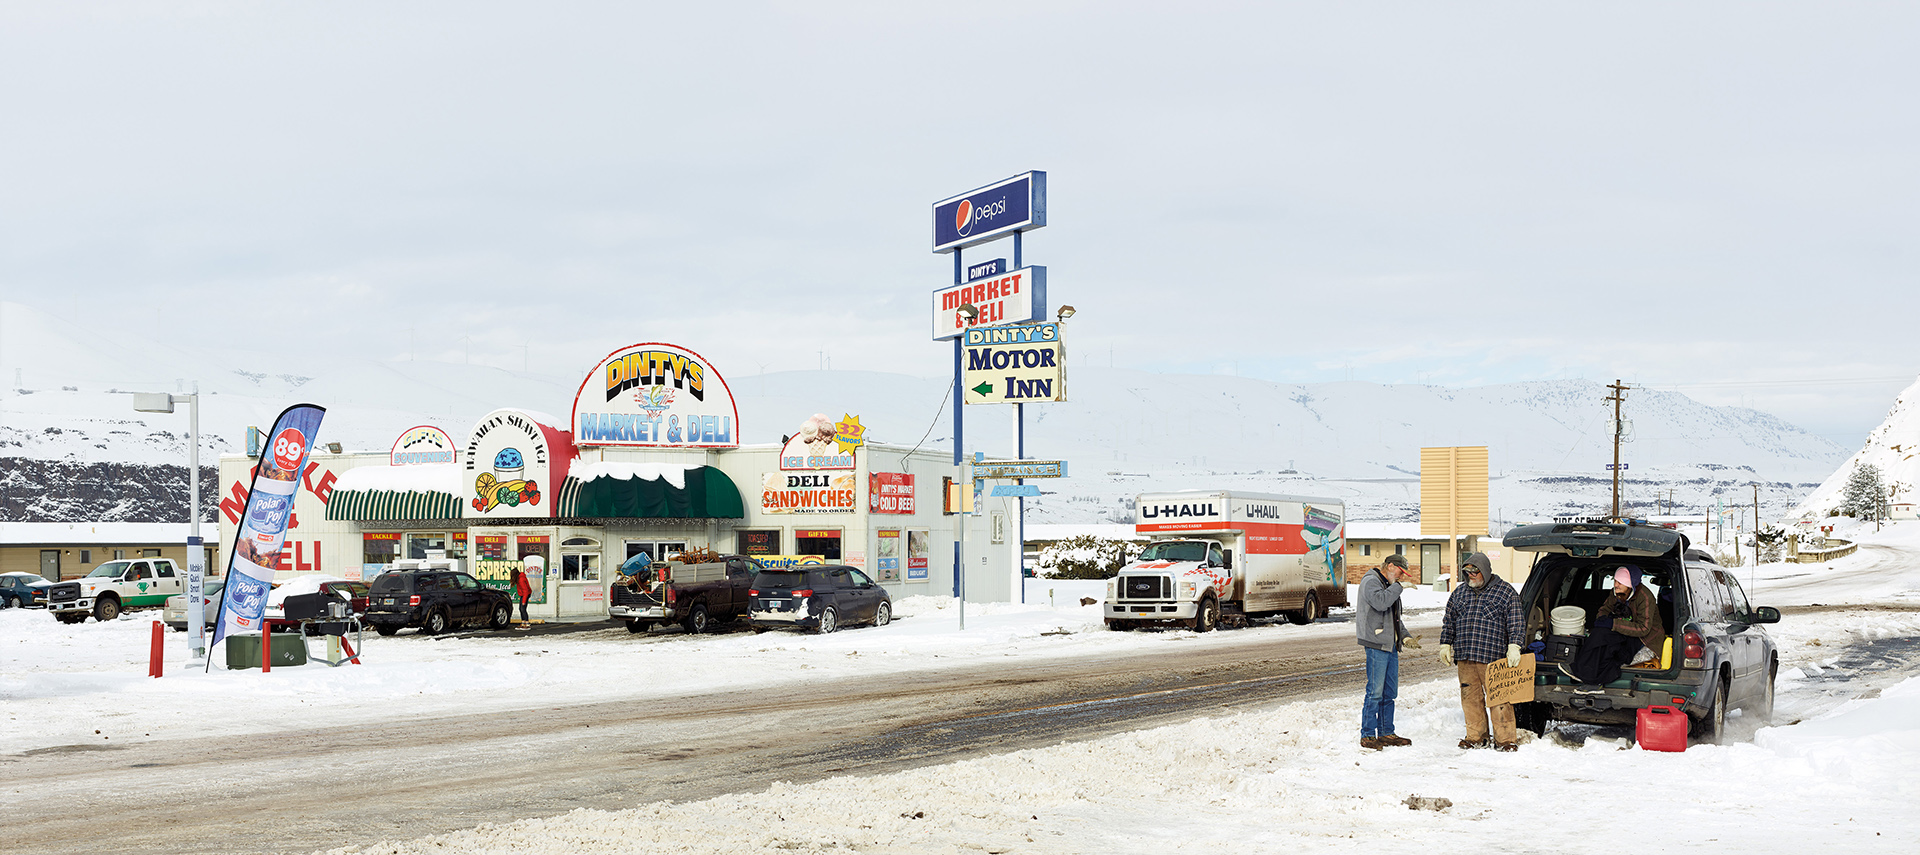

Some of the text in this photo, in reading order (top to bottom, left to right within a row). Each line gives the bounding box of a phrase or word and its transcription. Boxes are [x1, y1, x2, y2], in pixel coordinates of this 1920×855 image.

[975, 196, 1006, 224] pepsi
[970, 262, 997, 279] DINTY'S
[942, 274, 1021, 311] MARKET
[968, 325, 1055, 344] DINTY'S
[968, 347, 1056, 371] MOTOR
[606, 351, 703, 400] DINTY'S
[1005, 377, 1053, 399] INN
[580, 413, 730, 443] MARKET & DELI
[838, 423, 860, 437] 32
[403, 429, 443, 448] GIFTS
[507, 414, 541, 444] SHAVE
[534, 444, 546, 468] ICE
[836, 434, 861, 444] FLAVORS
[394, 451, 452, 464] SOUVENIRS
[783, 456, 852, 467] ICE CREAM
[787, 475, 830, 487] DELI
[881, 484, 913, 493] DINTY'S MARKET
[256, 498, 281, 511] Polar
[763, 490, 853, 507] SANDWICHES
[880, 496, 914, 510] COLD BEER
[1142, 504, 1219, 518] U-HAUL
[1246, 504, 1280, 519] U-HAUL
[526, 545, 544, 553] OPEN
